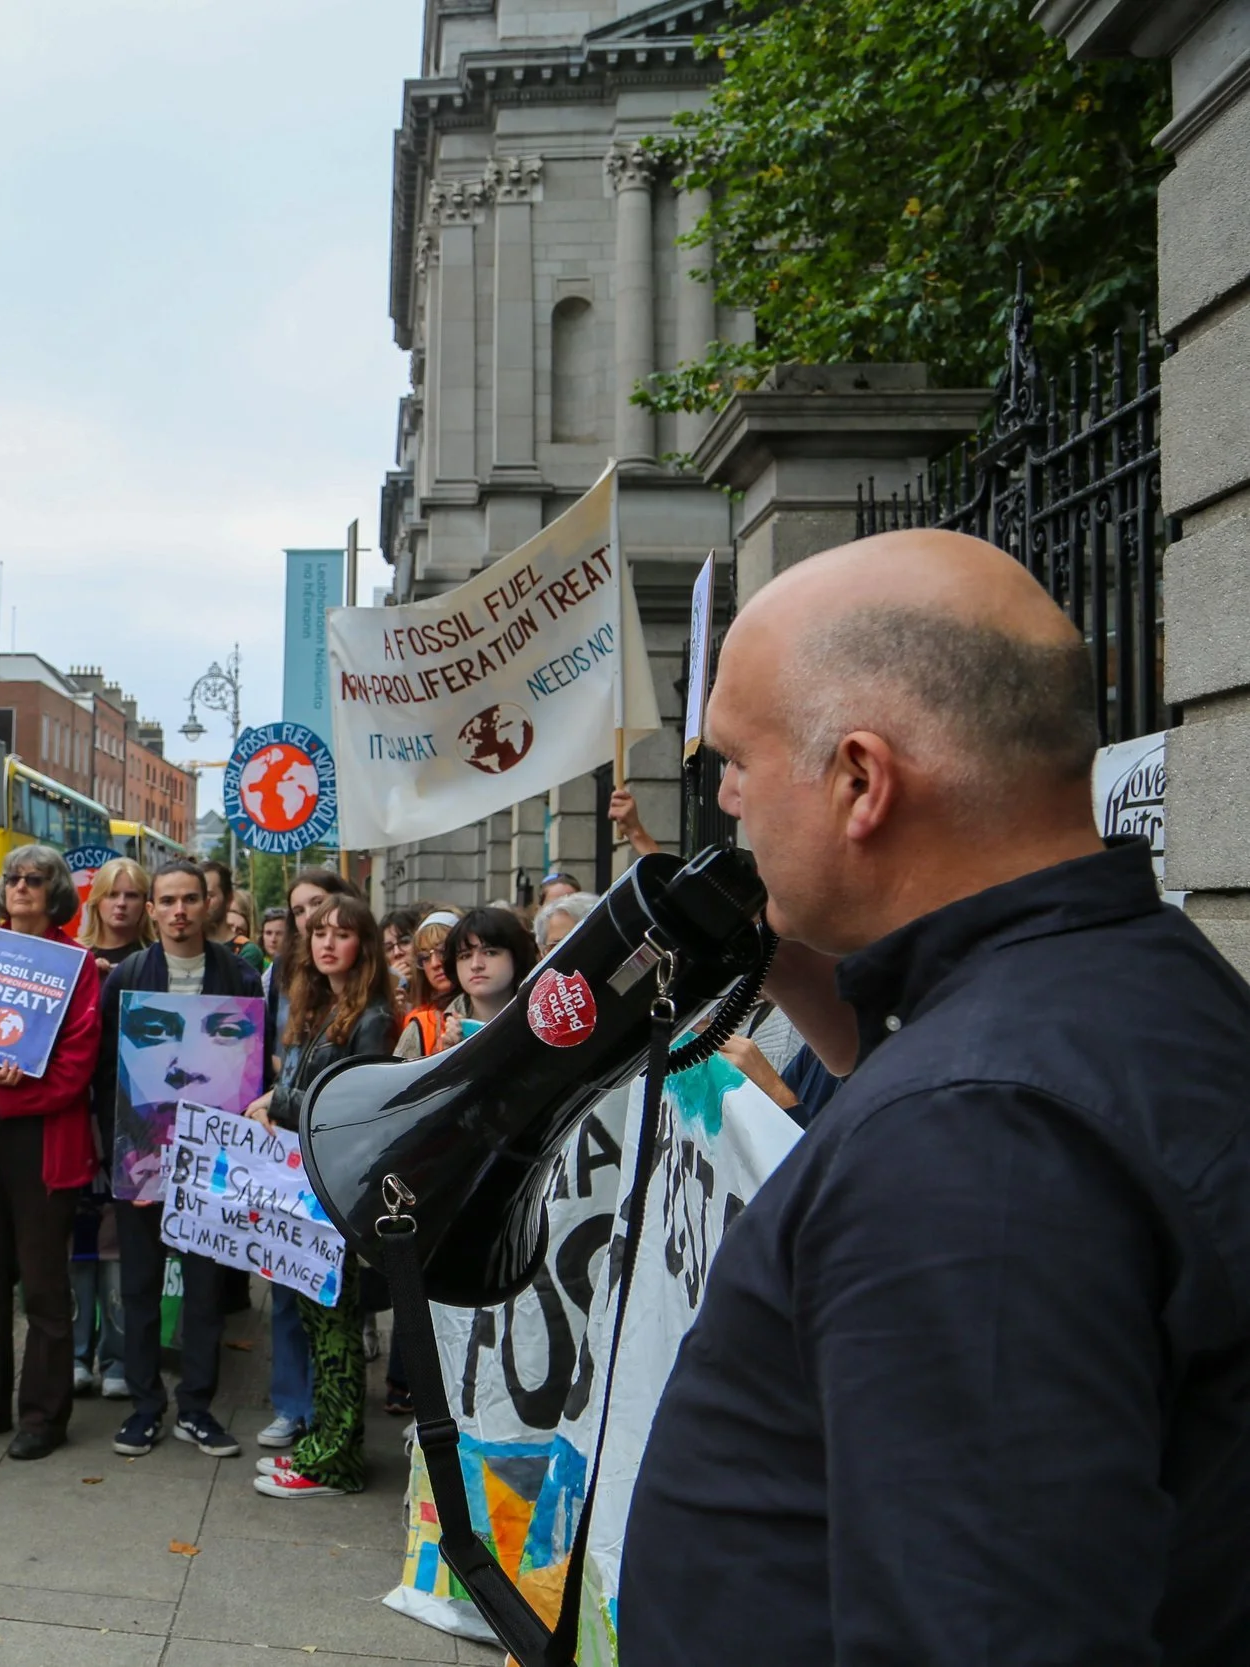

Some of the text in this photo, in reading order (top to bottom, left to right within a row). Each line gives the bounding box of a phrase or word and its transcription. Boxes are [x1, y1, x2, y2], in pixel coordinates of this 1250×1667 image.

[341, 543, 613, 705] NON-PROLIFERATION TREAT
[384, 564, 543, 661] A FOSSIL FUEL
[526, 623, 614, 701] NEEDS NO
[395, 734, 438, 762] WHAT
[225, 723, 336, 853] FOSSIL FUEL NON-PROLIFERATION TREATY
[1112, 799, 1164, 846] Leitr
[32, 971, 67, 990] FUEL
[548, 992, 565, 1023] out.
[554, 972, 584, 1032] walking
[570, 984, 586, 1009] I'm
[178, 1102, 287, 1163] IRELAND
[171, 1145, 211, 1189] BE
[222, 1165, 304, 1222] SMALL
[174, 1186, 347, 1266] BUT WE CARE ABOUT
[246, 1242, 325, 1292] CHANGE
